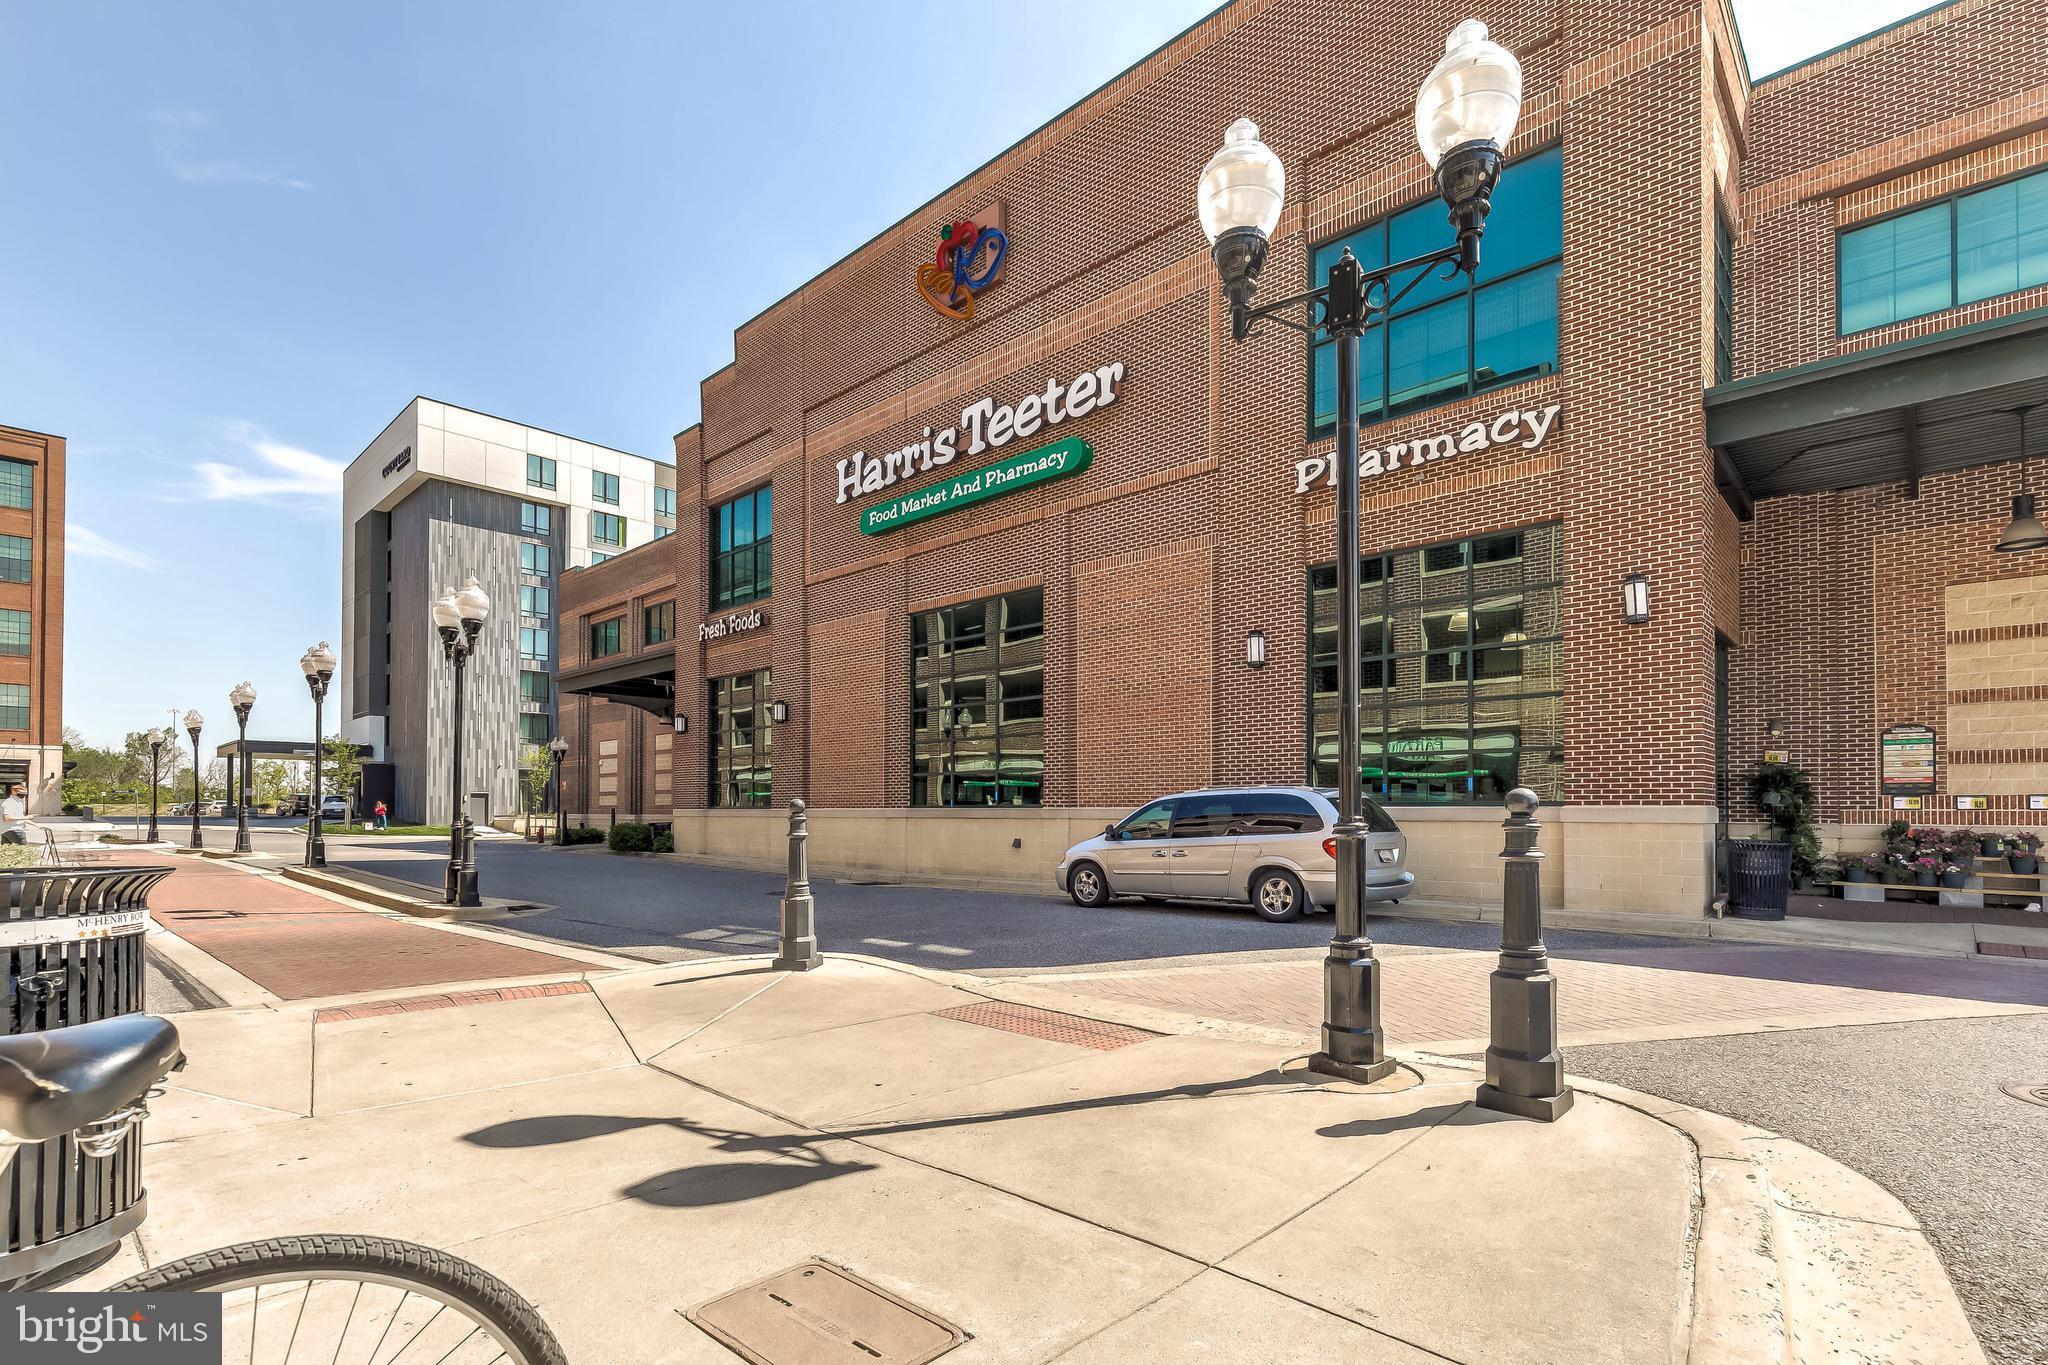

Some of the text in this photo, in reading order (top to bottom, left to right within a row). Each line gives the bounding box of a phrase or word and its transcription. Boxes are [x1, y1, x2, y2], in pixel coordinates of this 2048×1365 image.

[835, 362, 1124, 504] Harris Teeter
[868, 450, 1068, 526] Food Market And Pharmacy
[699, 609, 761, 641] Fresh Foods
[130, 911, 144, 922] ROW
